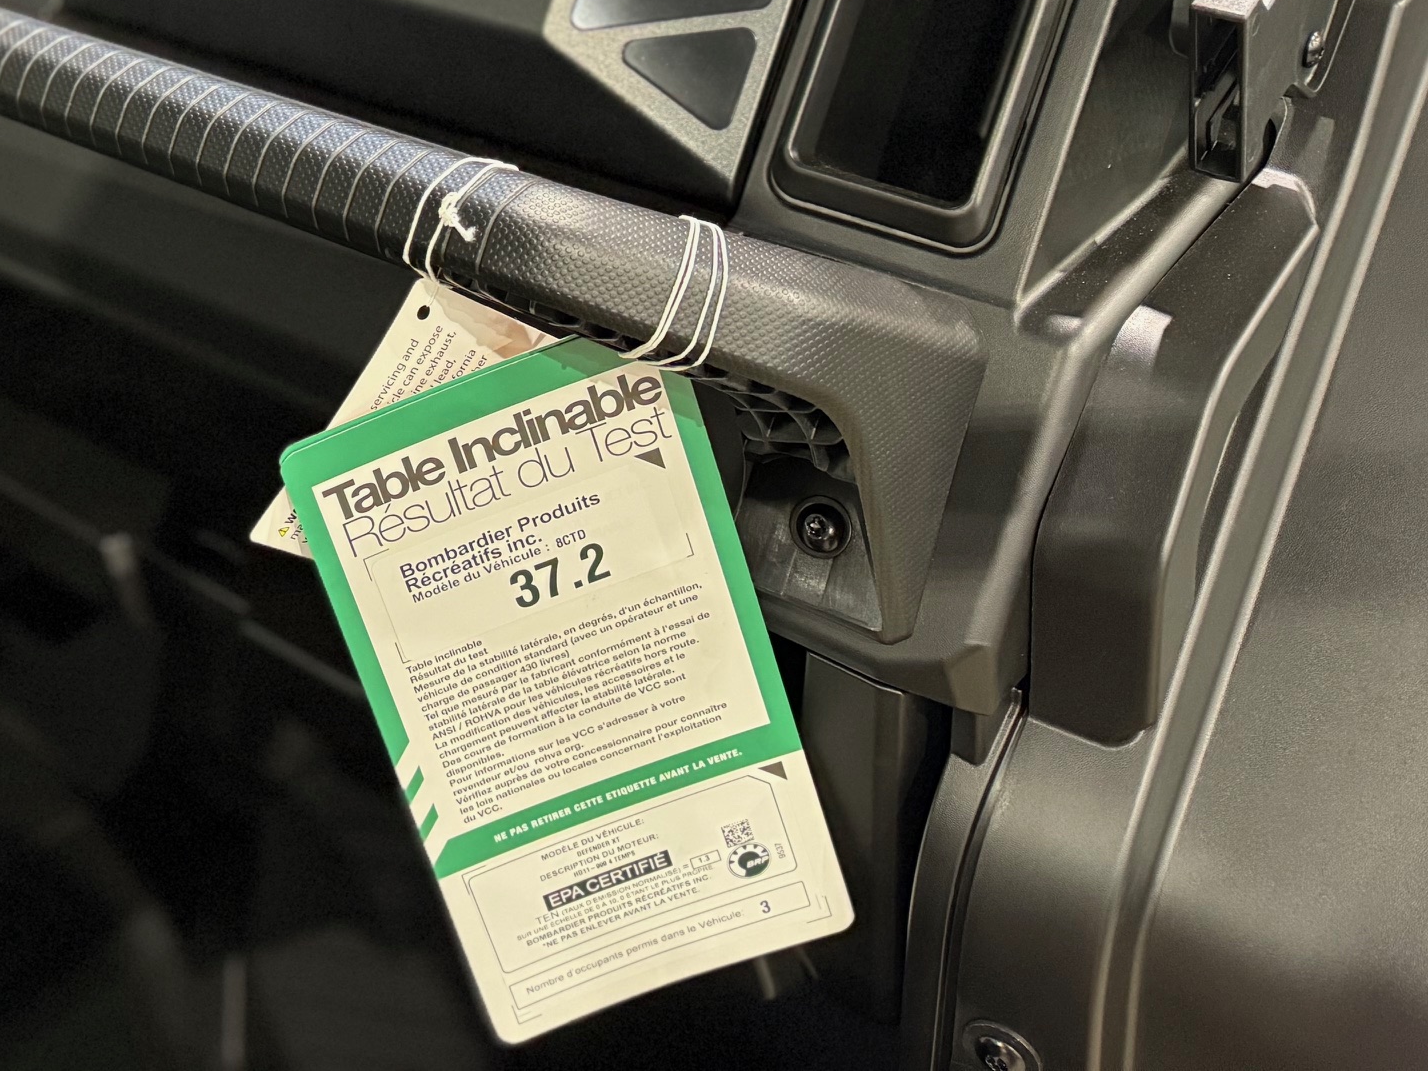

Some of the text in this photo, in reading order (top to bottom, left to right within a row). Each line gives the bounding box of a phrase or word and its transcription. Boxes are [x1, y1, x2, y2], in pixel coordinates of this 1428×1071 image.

[370, 338, 419, 410] servicing and
[402, 367, 419, 386] can
[416, 325, 443, 365] expose
[425, 331, 456, 376] exhaust,
[433, 359, 457, 385] lead,
[321, 372, 663, 520] Table Inclinable
[341, 401, 672, 558] Résultat du Test
[399, 493, 600, 579] Bombardier Produits
[404, 534, 542, 593] Récréatifs inc.
[411, 529, 586, 603] Modèle du Véhicule 8CTD
[509, 542, 611, 608] 37.2
[405, 640, 482, 674] Table inclinable
[409, 647, 488, 684] Résultat du test
[413, 582, 702, 694] Mesure de stabilité latérale, en degrés, d'un échantillon,
[416, 594, 698, 703] véhicule de condition standard (avec un opérateur et une
[423, 611, 710, 721] Tel que mesuré par fabricant conformément l'essai de
[420, 649, 570, 712] charge de passager 430 livres)
[428, 631, 686, 731] stabilité latérale de table élévatrice selon norme
[432, 638, 699, 741] ANSI ROHVA pour les véhicules récréatifs hors route.
[434, 655, 674, 750] La modification des véhicules, les accessoires et
[438, 668, 675, 759] chargement peuvent affecter stabilité latérale.
[441, 672, 686, 769] Des cours de formation conduite de VCC sont
[448, 695, 685, 787] Pour informations sur les VCC s'adresser votre
[455, 702, 727, 805] Vérifiez auprès de votre concessionnaire pour connaître
[445, 751, 505, 778] disponibles.
[452, 772, 501, 796] revendeur
[503, 761, 530, 776] et/ou
[533, 749, 562, 765] rohva
[459, 714, 722, 815] les lois nationales ou locales concernant l'exploitation
[493, 748, 743, 843] NE PAS RETIRER CETTE ETIQUETTE AVANT LA VENTE.
[463, 803, 503, 824] du VCC.
[540, 818, 644, 861] MODÈLE DU VÉHICULE:
[539, 833, 659, 882] DESCRIPTION DU MOTEUR:
[548, 851, 667, 907] EPA CERTIFIÉ
[746, 856, 769, 869] BRP
[525, 917, 586, 946] BOMBARDIER
[587, 899, 633, 922] PRODUITS
[634, 879, 691, 904] RÉCRÉATIFS
[759, 899, 771, 914] 3
[525, 908, 746, 995] Nombre d'occupants permis dans Véhicule:
